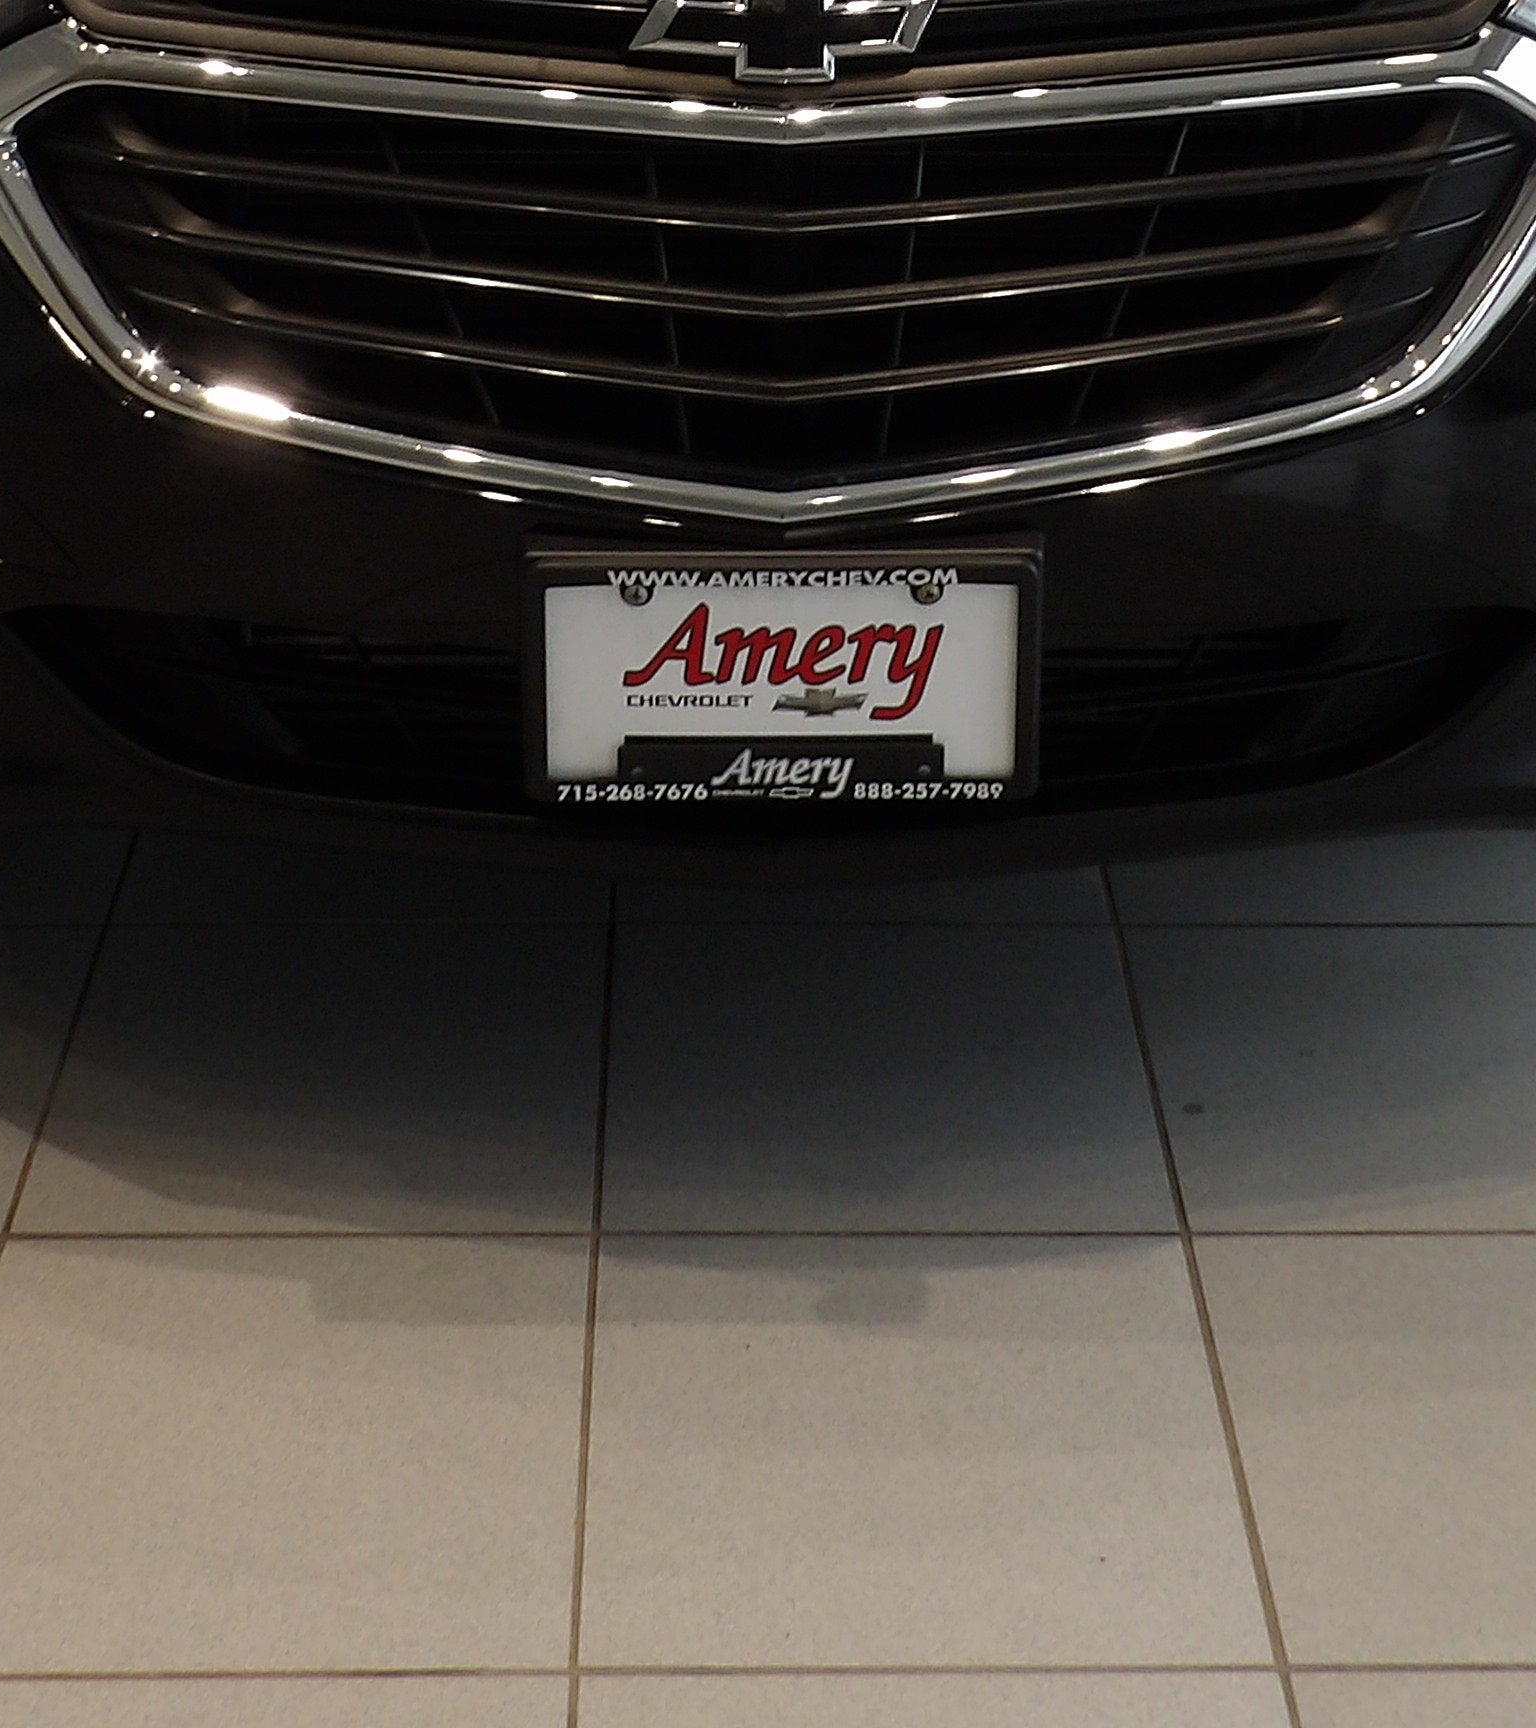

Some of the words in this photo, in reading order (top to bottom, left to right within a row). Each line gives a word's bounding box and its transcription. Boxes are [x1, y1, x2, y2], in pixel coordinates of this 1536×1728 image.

[607, 569, 958, 588] WWW.AMERYCHEV.COM
[623, 602, 944, 720] Amery
[627, 695, 754, 707] CHEVROLET
[711, 747, 854, 799] Amery
[557, 783, 708, 801] 715-268-7676
[854, 782, 1003, 800] 888-257-7989
